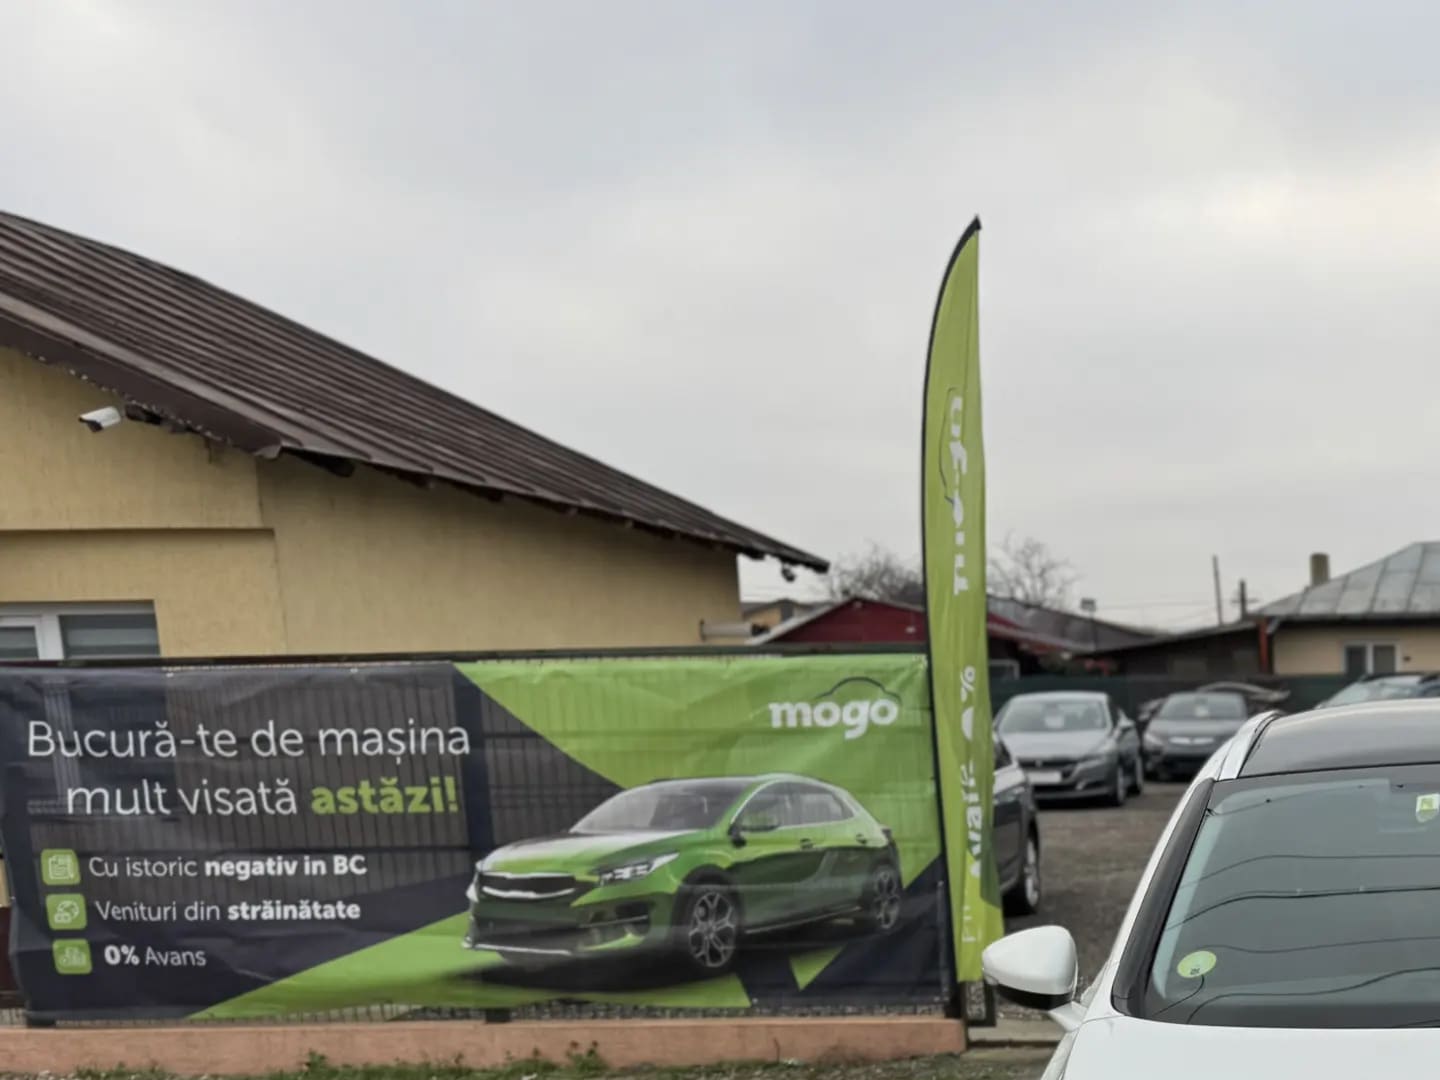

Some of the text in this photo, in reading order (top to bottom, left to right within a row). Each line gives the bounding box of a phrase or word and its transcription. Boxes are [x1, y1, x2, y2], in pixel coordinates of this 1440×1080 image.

[768, 698, 899, 739] mogo
[28, 718, 471, 765] Bucură-te de mașina
[66, 776, 458, 816] mult visată astăzi!
[88, 854, 368, 881] Cu istoric negativ in BC
[94, 899, 361, 922] Venituri din străinătate
[104, 944, 207, 967] 0% Avans
